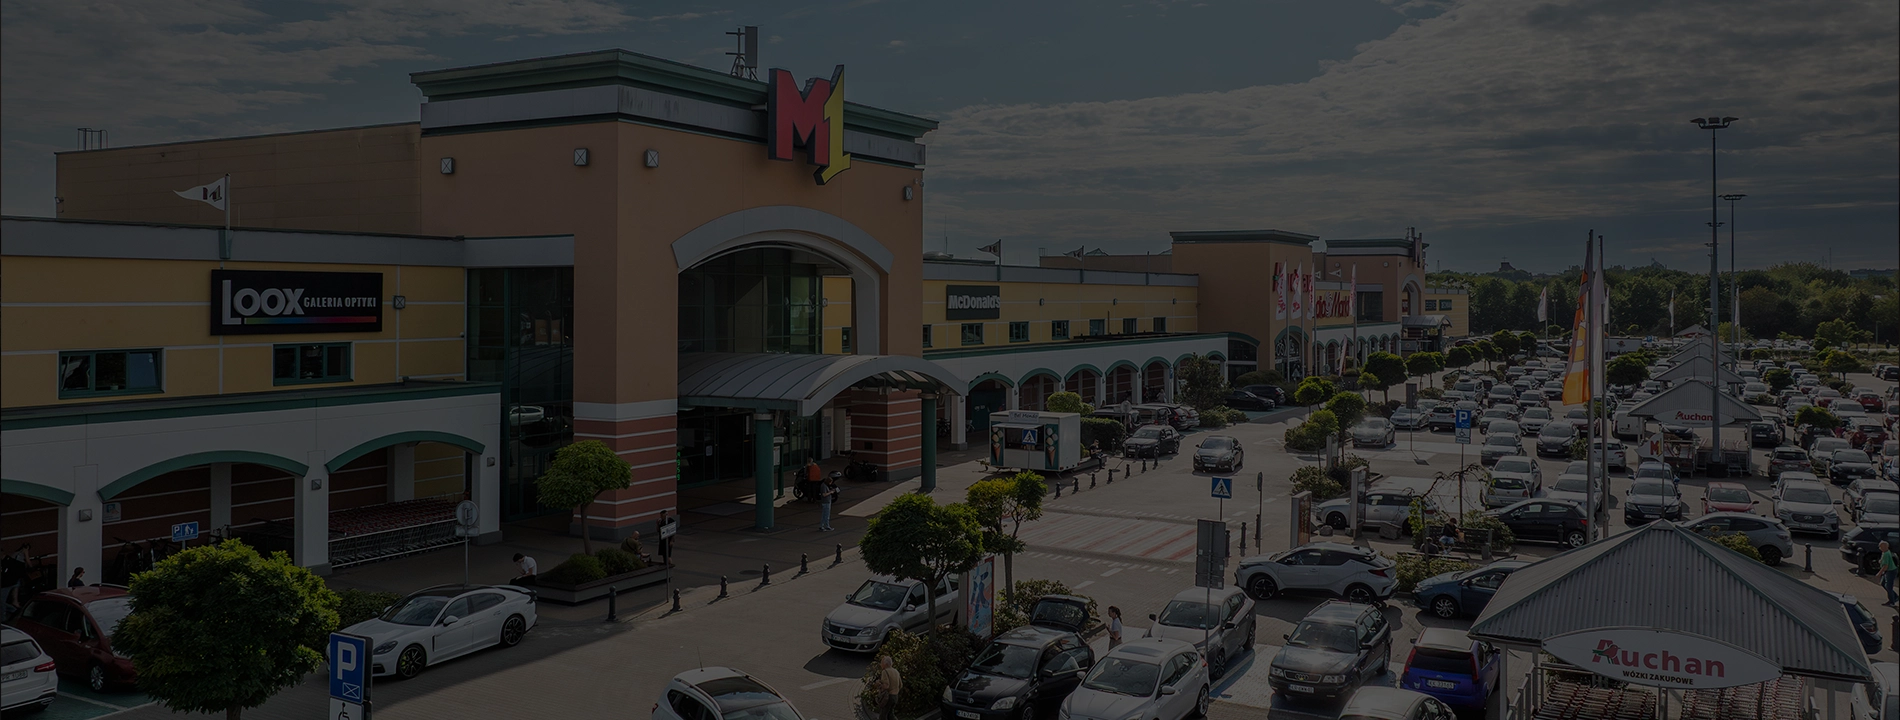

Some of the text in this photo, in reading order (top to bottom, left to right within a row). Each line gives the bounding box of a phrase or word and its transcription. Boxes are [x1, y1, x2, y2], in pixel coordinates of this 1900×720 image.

[768, 64, 851, 185] M1
[304, 297, 343, 308] GALERIA
[344, 297, 377, 308] OPTYKI
[947, 294, 1000, 309] McDonald's
[1459, 412, 1468, 422] P
[1675, 411, 1713, 421] Auchan
[174, 526, 181, 534] P
[337, 641, 357, 680] P
[1592, 639, 1725, 678] Auchan
[1622, 670, 1694, 685] WÓZKI ZAKUPOWE
